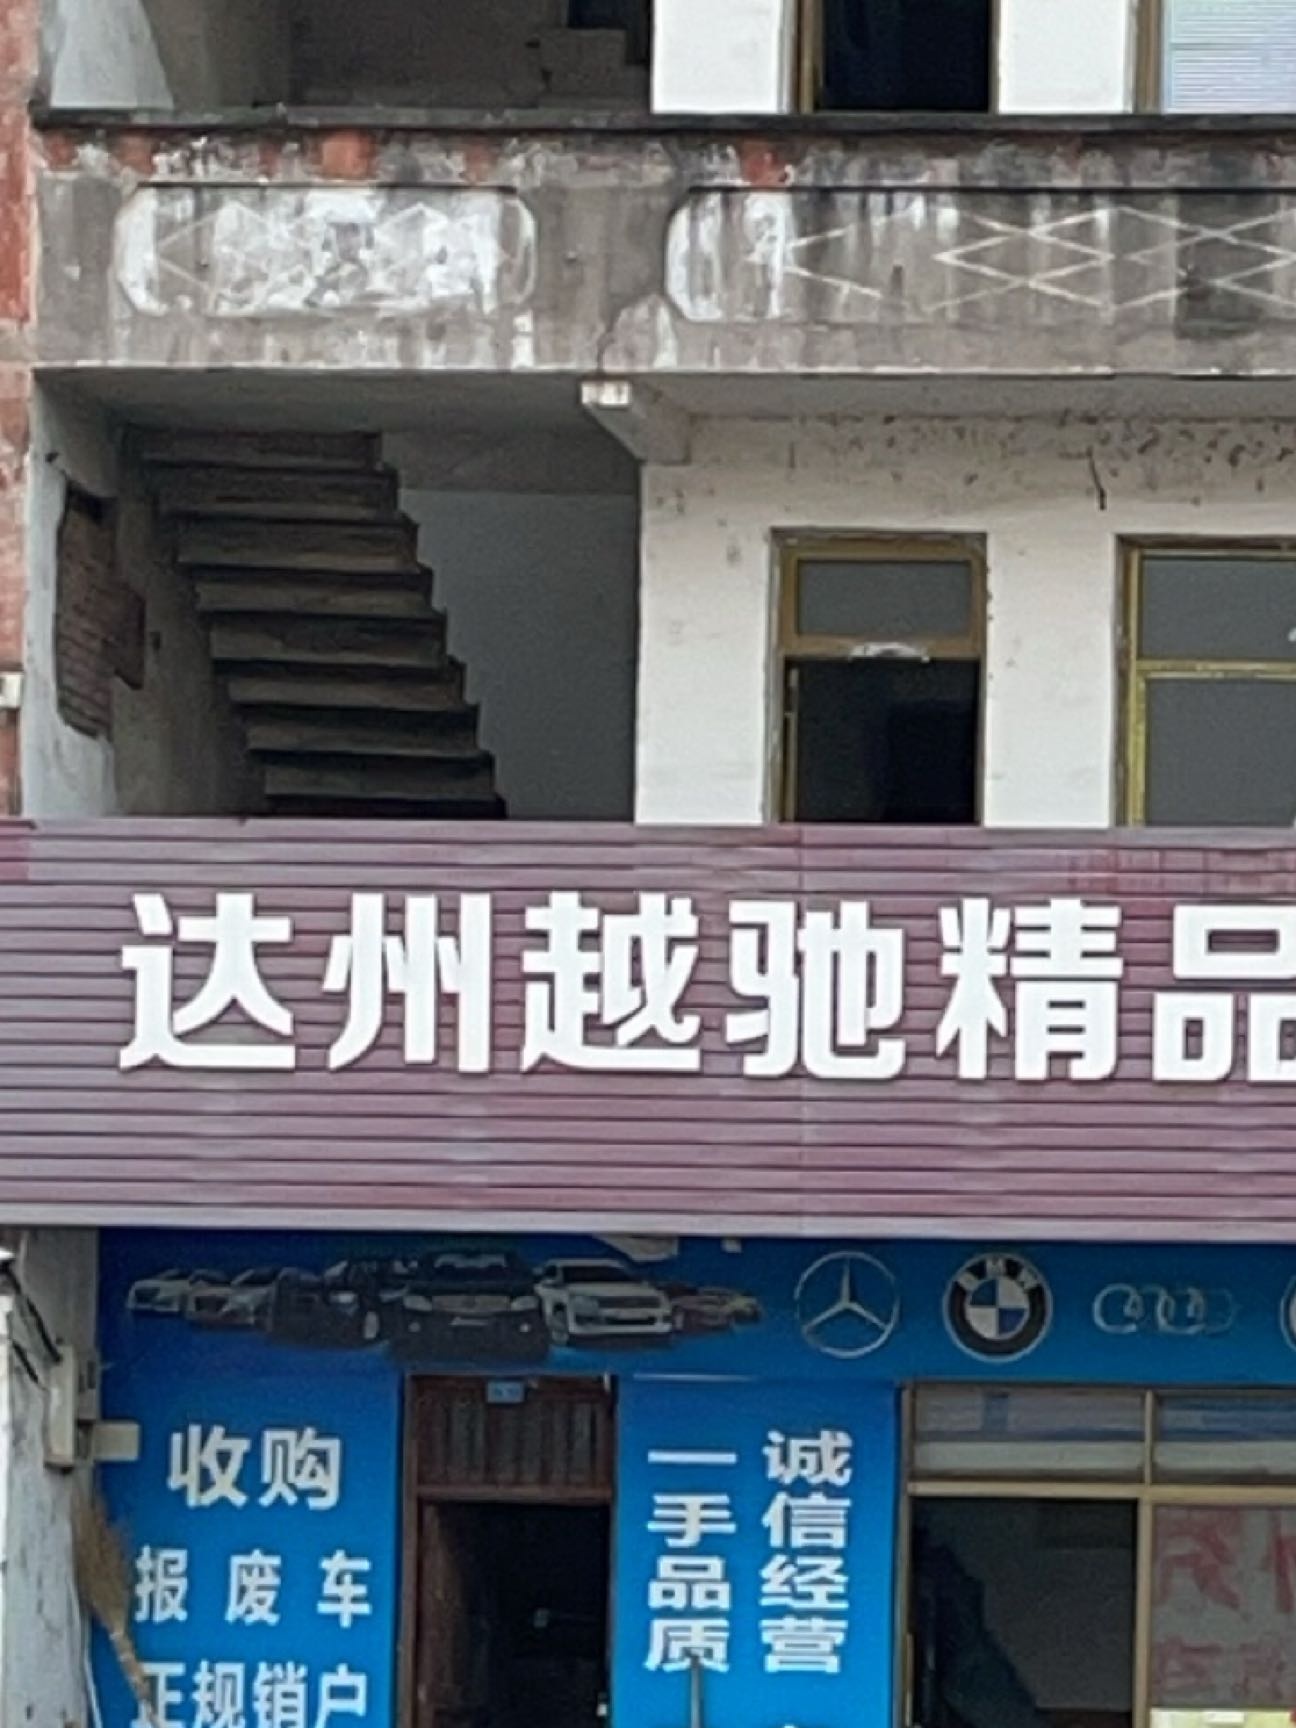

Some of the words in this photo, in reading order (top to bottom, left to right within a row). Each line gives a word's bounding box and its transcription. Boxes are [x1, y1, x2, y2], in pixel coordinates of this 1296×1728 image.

[167, 1424, 342, 1510] 收购
[134, 1546, 371, 1628] 报废车
[645, 1451, 737, 1673] 一手品质
[760, 1429, 853, 1674] 诚信经营
